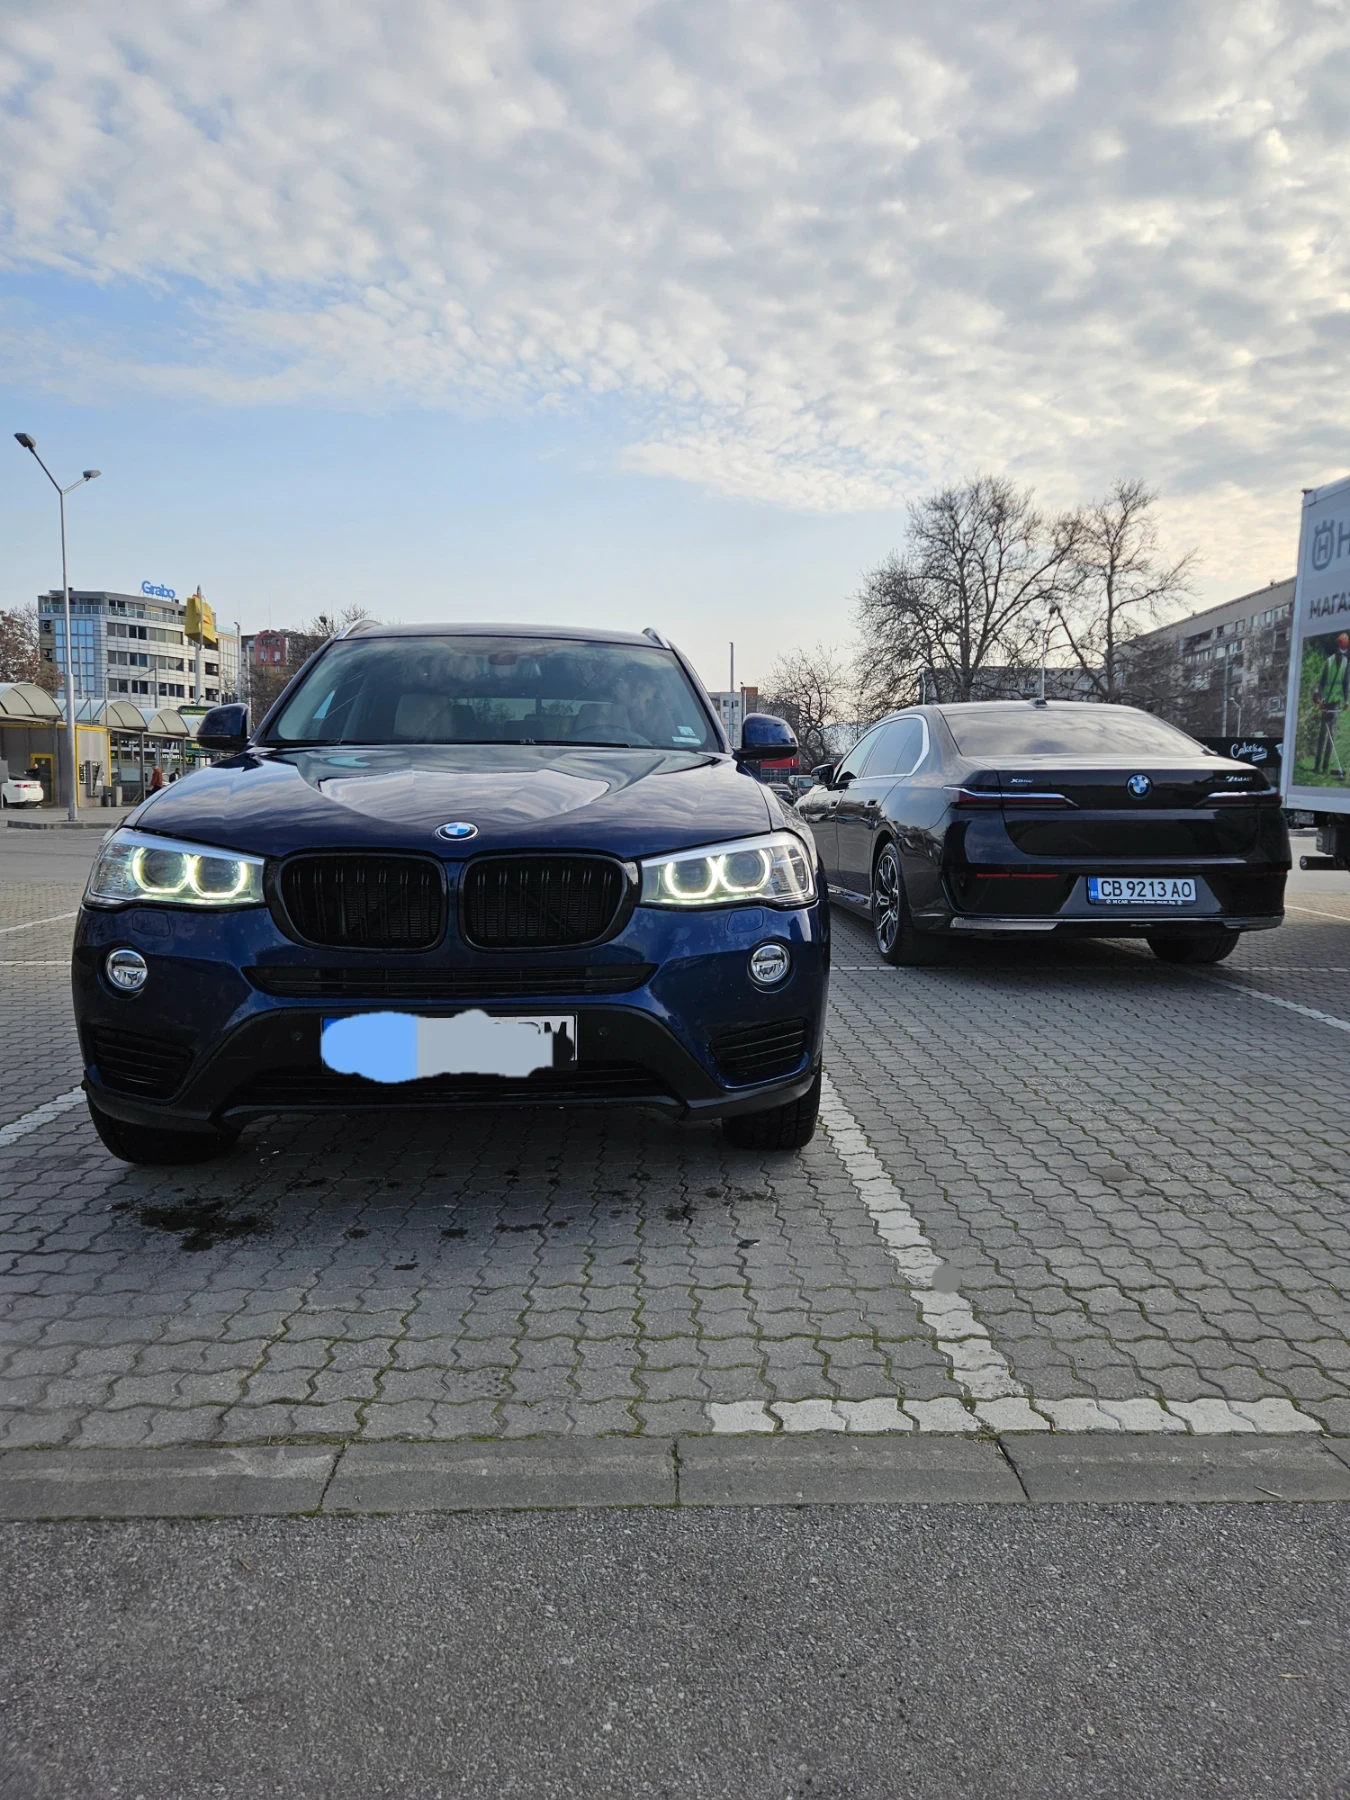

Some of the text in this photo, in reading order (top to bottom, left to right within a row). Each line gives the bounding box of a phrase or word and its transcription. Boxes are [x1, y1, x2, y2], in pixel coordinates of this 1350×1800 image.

[142, 580, 176, 599] Grabo
[1308, 591, 1350, 620] МАГА
[1101, 880, 1192, 898] CB 9213 AO
